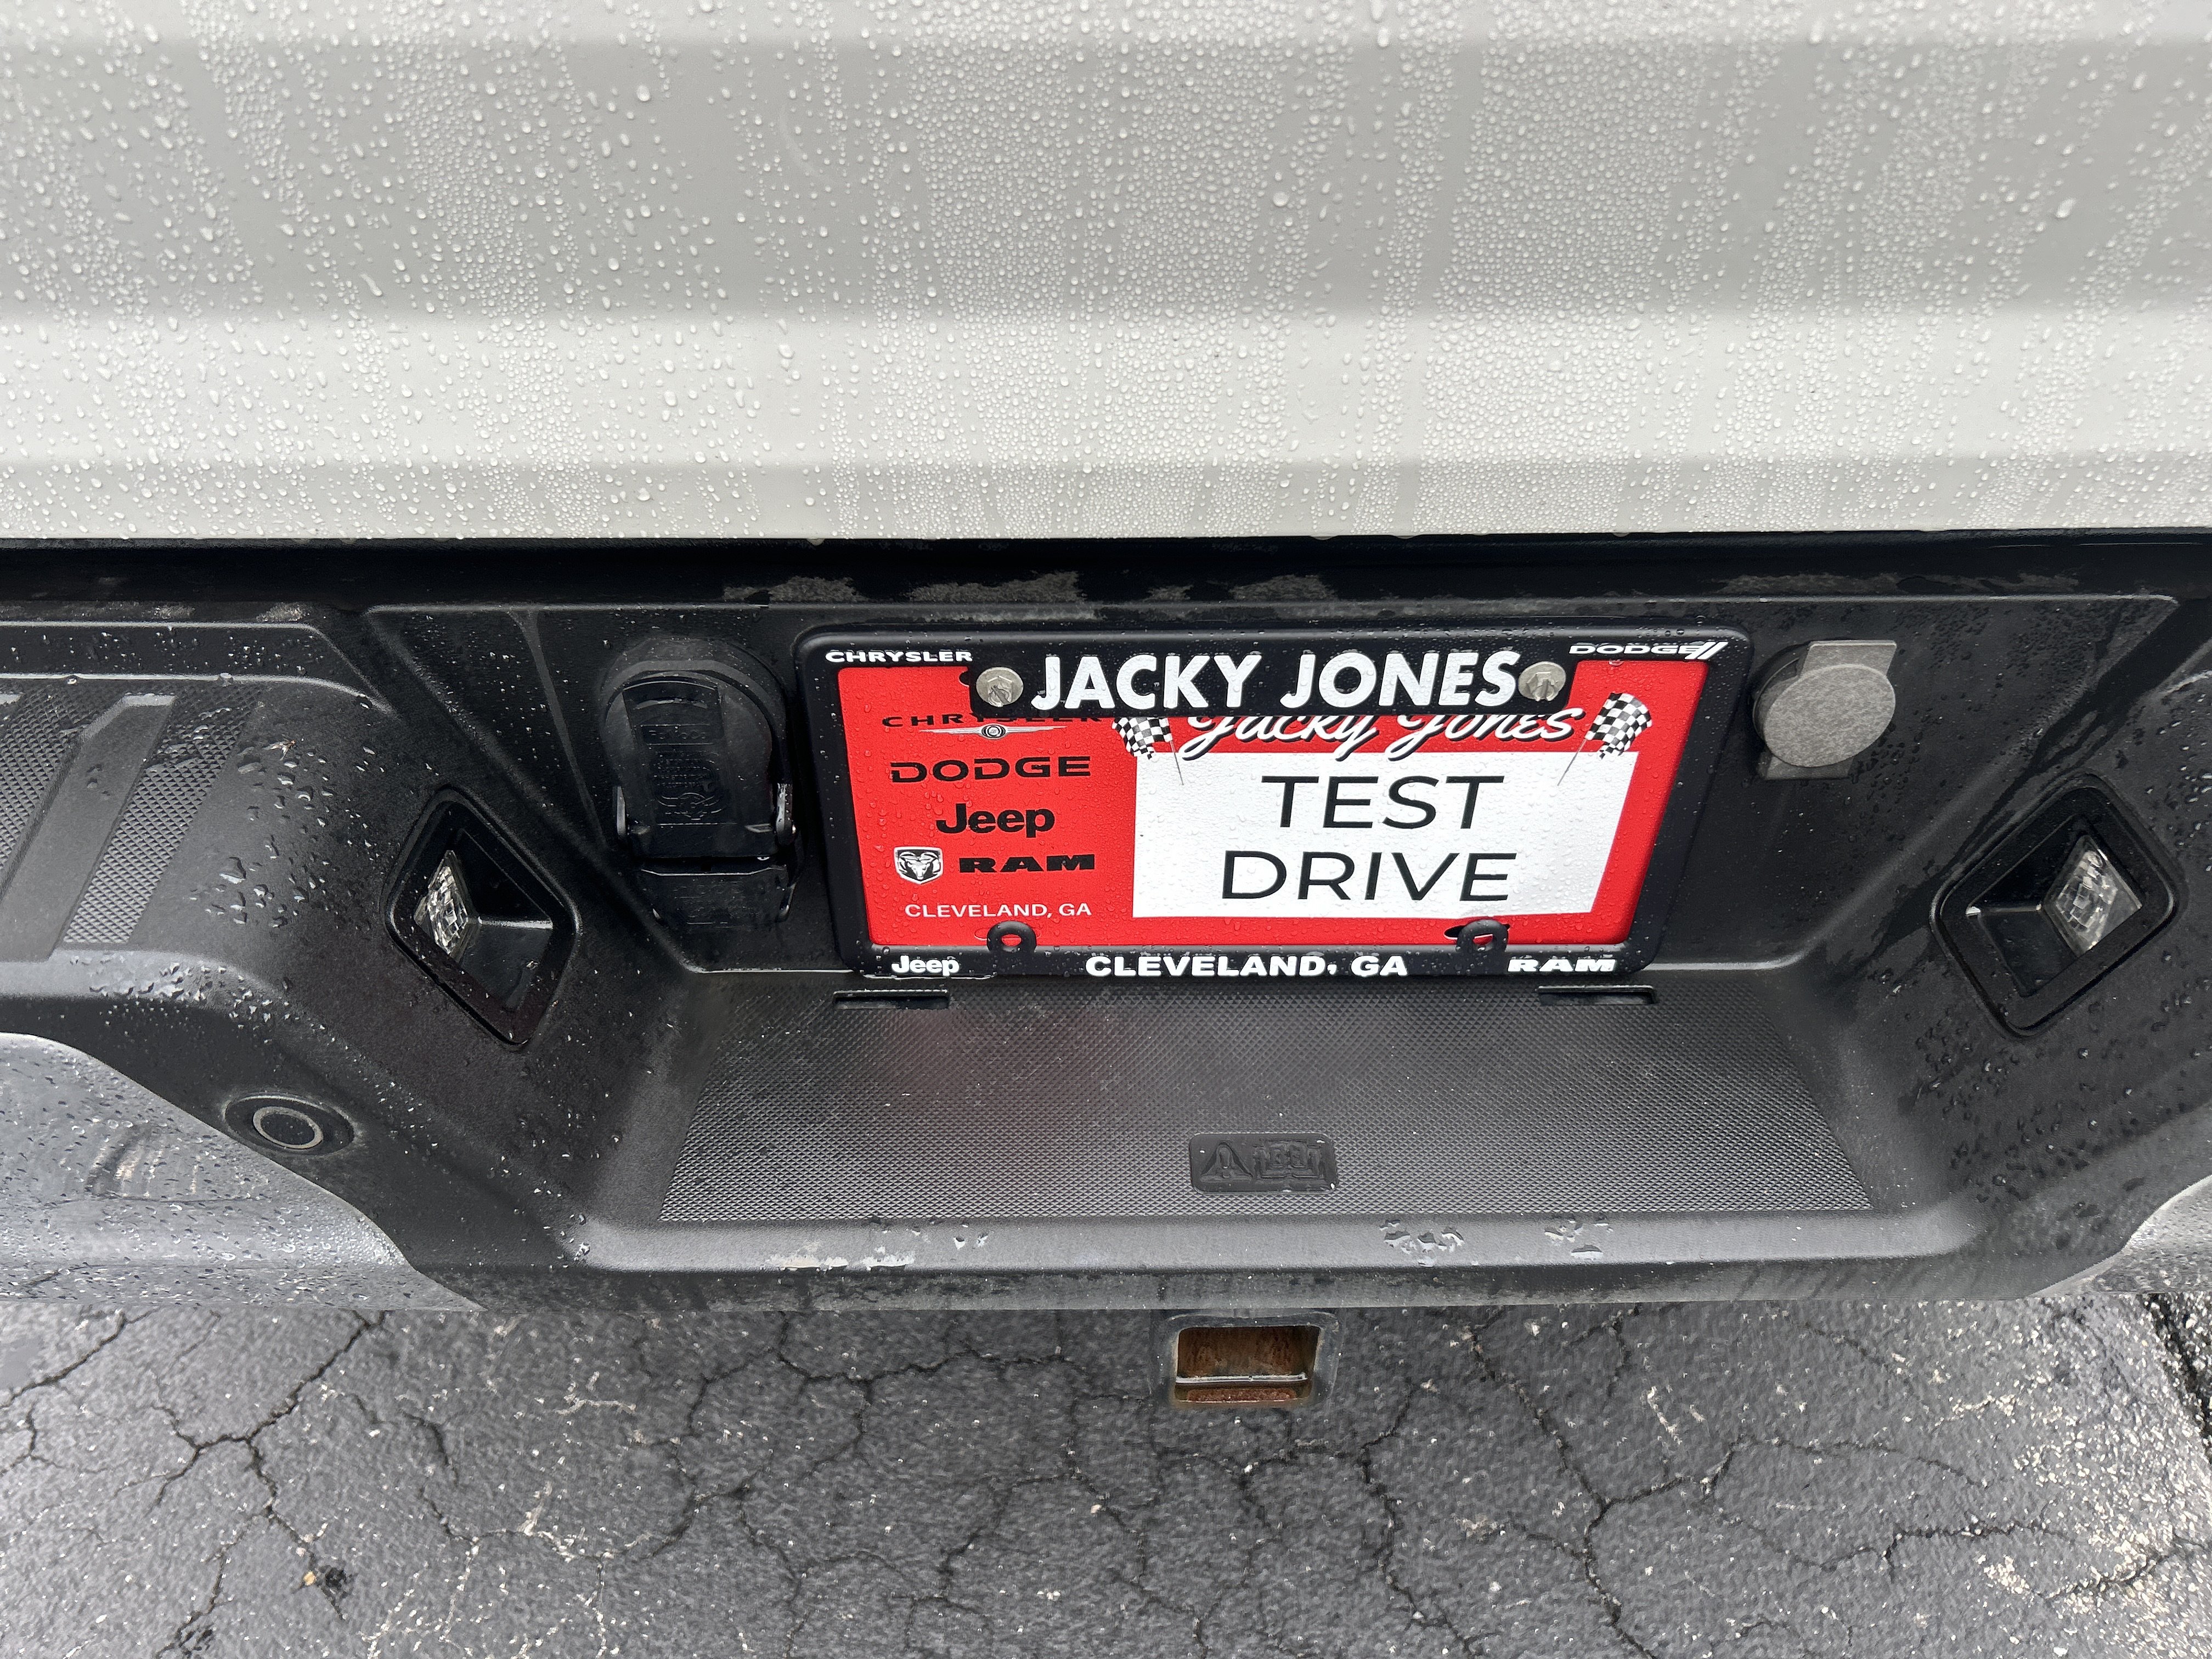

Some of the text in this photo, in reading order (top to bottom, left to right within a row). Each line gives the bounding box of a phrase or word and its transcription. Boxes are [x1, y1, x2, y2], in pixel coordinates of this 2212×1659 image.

[825, 651, 973, 663] CHRYSLER
[1568, 644, 1703, 655] DODGE
[1031, 651, 1521, 710] JACKY JONES
[890, 755, 1091, 783] DODGE
[1261, 775, 1505, 830] TEST
[935, 803, 1056, 838] Jeep
[958, 854, 1096, 873] RAM
[1221, 850, 1517, 902] DRIVE
[905, 902, 1092, 920] CLEVELAND, GA
[891, 955, 960, 977] Jeep
[1085, 955, 1408, 977] CLEVELAND, GA
[1507, 958, 1617, 973] RAM
